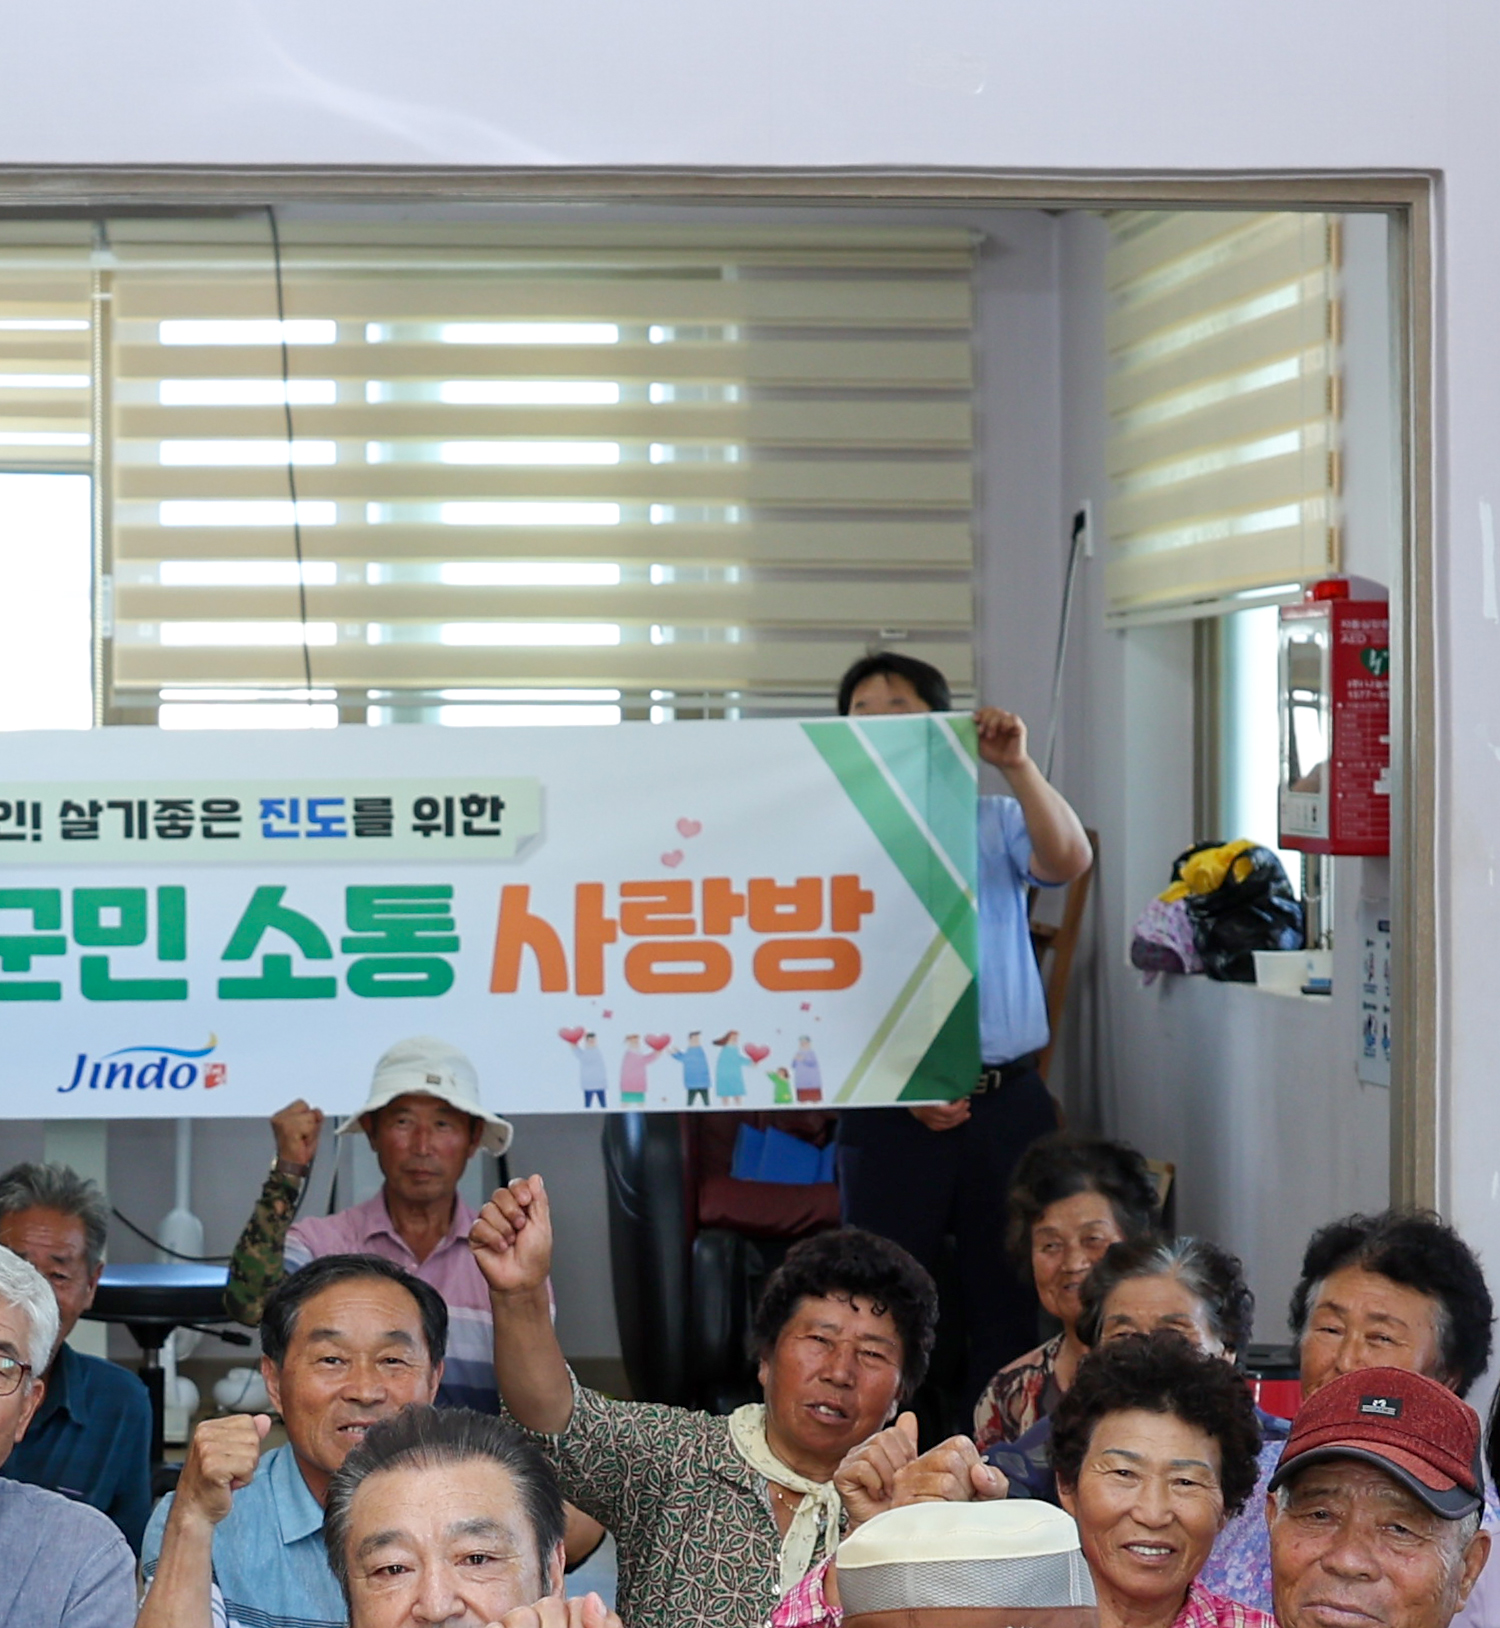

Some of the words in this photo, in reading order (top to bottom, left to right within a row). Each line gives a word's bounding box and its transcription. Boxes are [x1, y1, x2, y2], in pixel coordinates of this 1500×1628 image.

[1341, 630, 1368, 645] AED
[59, 799, 243, 840] 살기좋은
[259, 797, 395, 839] 진도를
[411, 794, 506, 838] 위한
[216, 884, 461, 1000] 소통
[489, 874, 875, 996] 사랑방
[57, 1052, 199, 1093] Jindo
